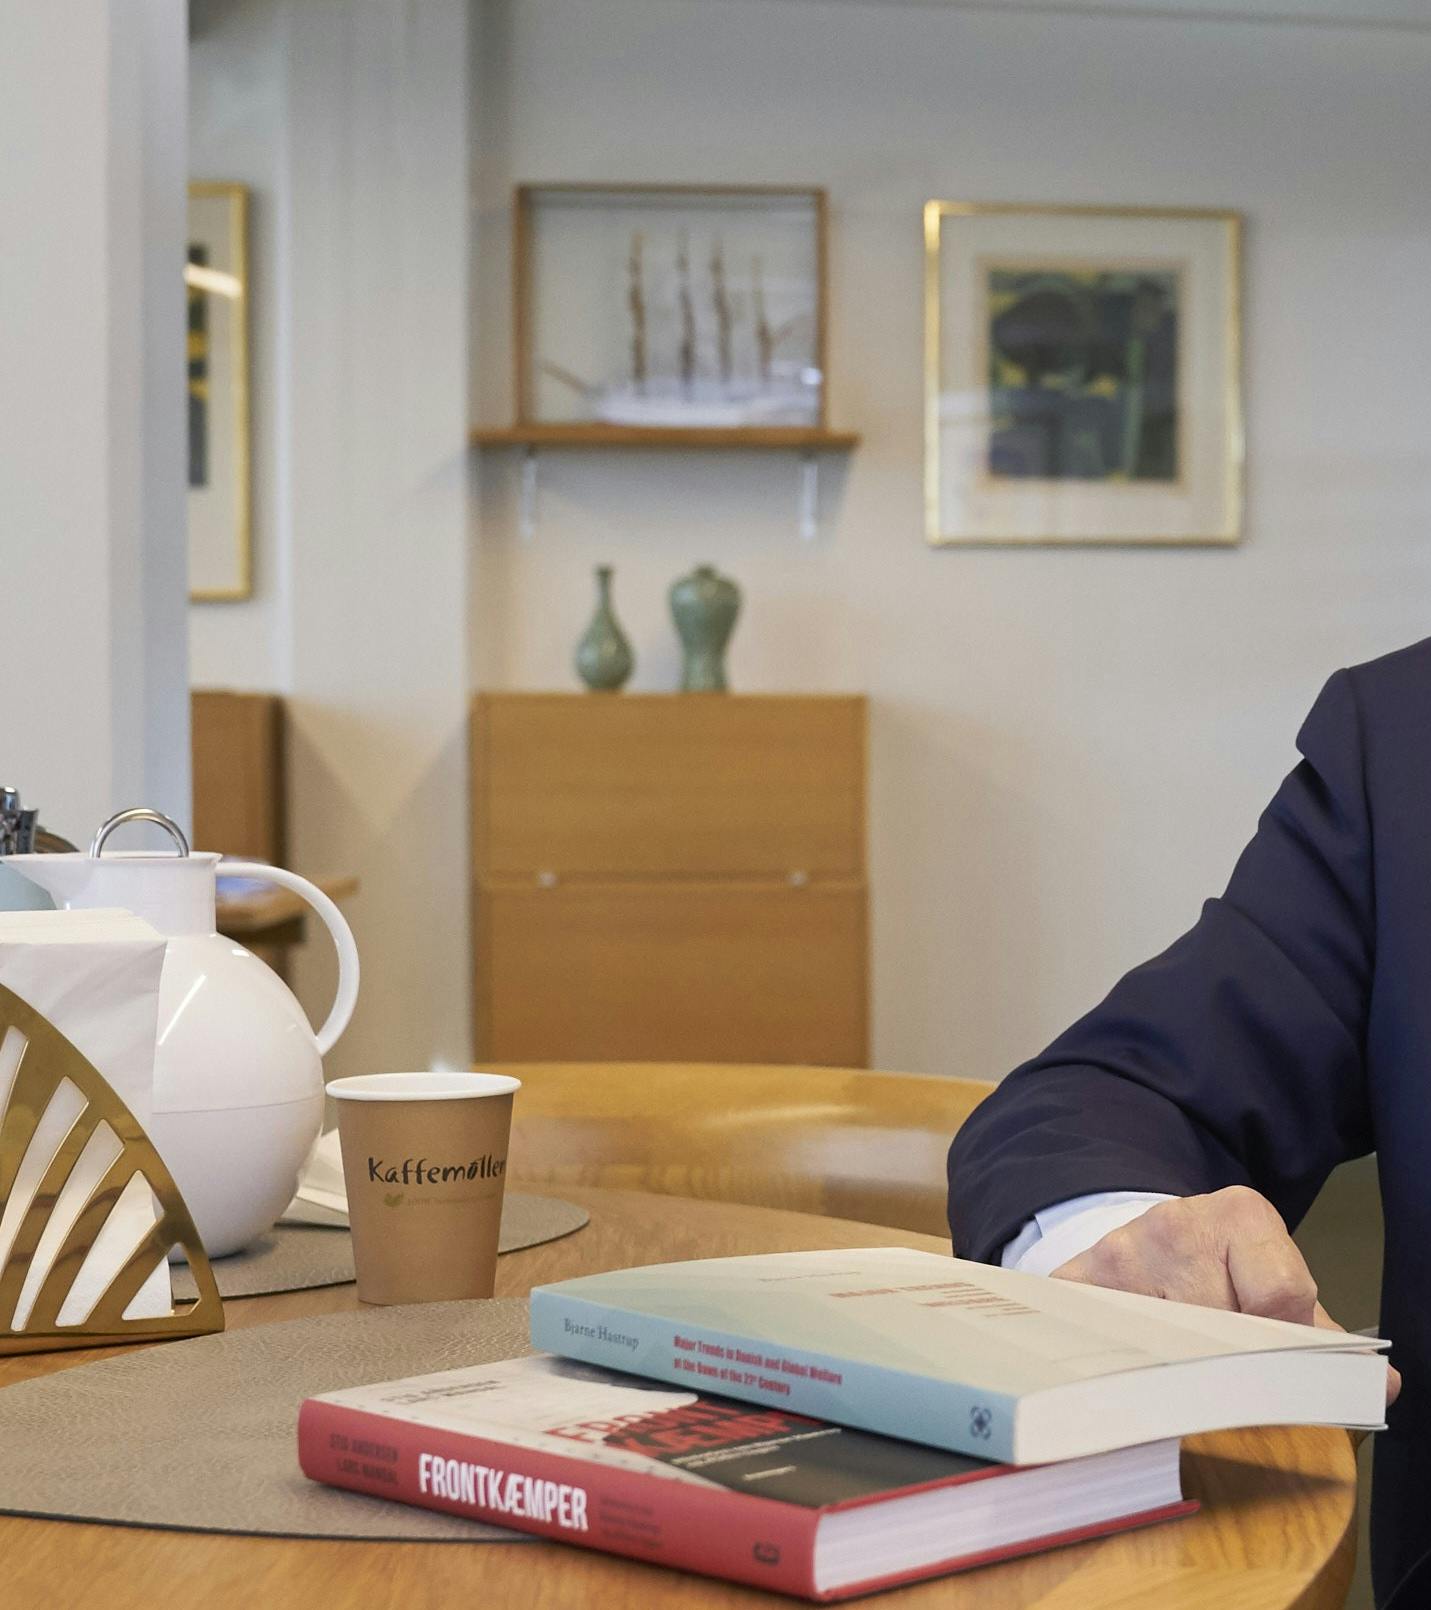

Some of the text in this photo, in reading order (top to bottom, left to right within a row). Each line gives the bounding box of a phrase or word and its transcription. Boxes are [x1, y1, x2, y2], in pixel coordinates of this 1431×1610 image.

[564, 1318, 640, 1352] Bjarne Hastrup
[674, 1335, 696, 1351] Major
[698, 1340, 725, 1359] Trends
[736, 1349, 763, 1366] Danish
[765, 1357, 780, 1371] and
[782, 1360, 808, 1377] Global
[810, 1366, 843, 1385] Welfare
[683, 1359, 695, 1372] the
[697, 1361, 718, 1378] Dawn
[730, 1369, 742, 1383] the
[758, 1376, 791, 1396] Century
[418, 1452, 589, 1532] FRONTKÆMPER
